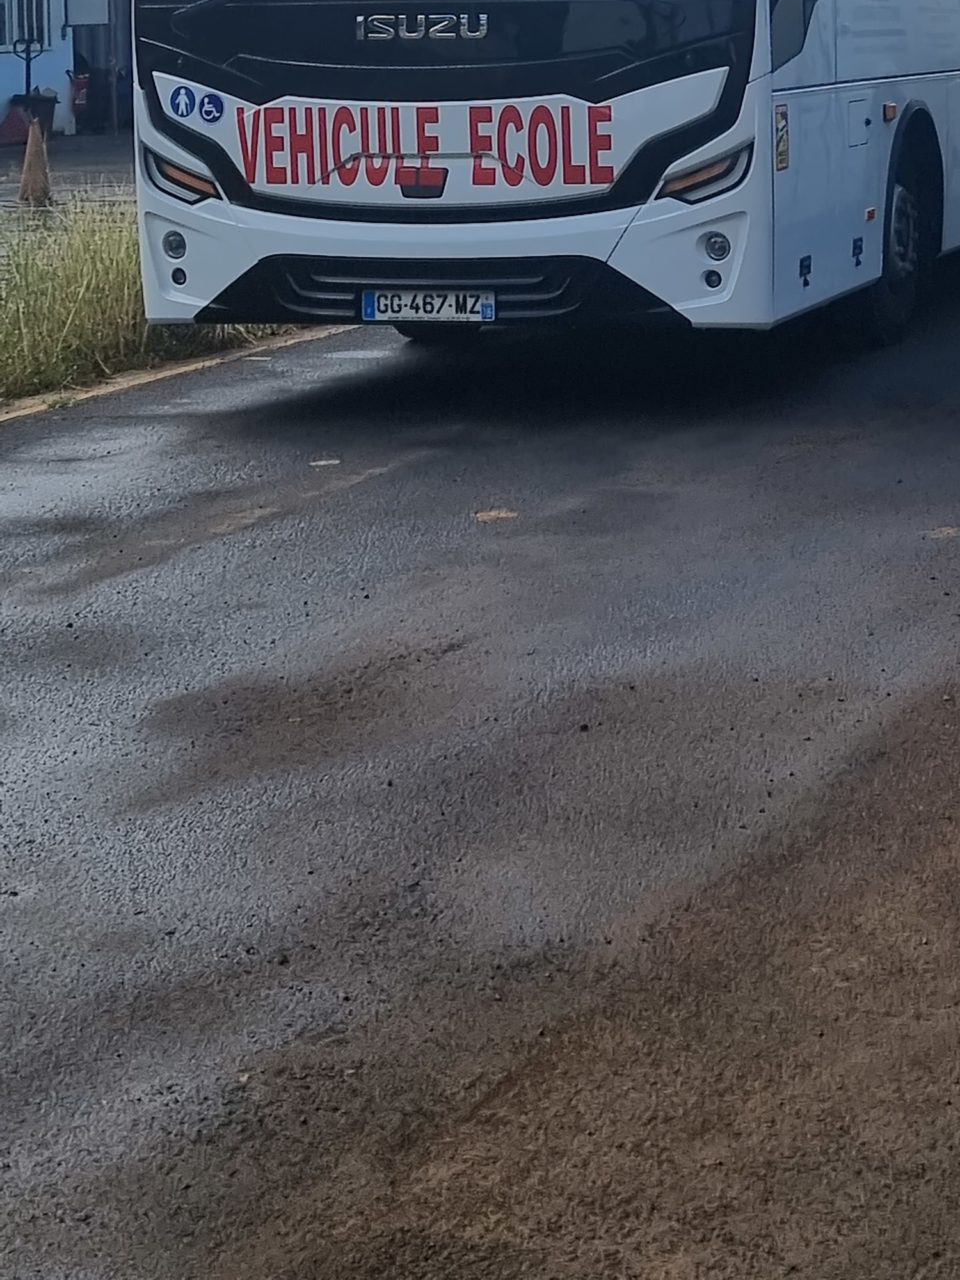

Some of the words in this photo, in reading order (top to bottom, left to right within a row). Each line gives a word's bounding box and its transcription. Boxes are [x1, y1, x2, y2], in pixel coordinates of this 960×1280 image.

[356, 14, 488, 40] ISUZU
[236, 105, 446, 187] VEHICULE
[469, 104, 614, 187] ECOLE
[376, 293, 481, 315] GG-467-MZ
